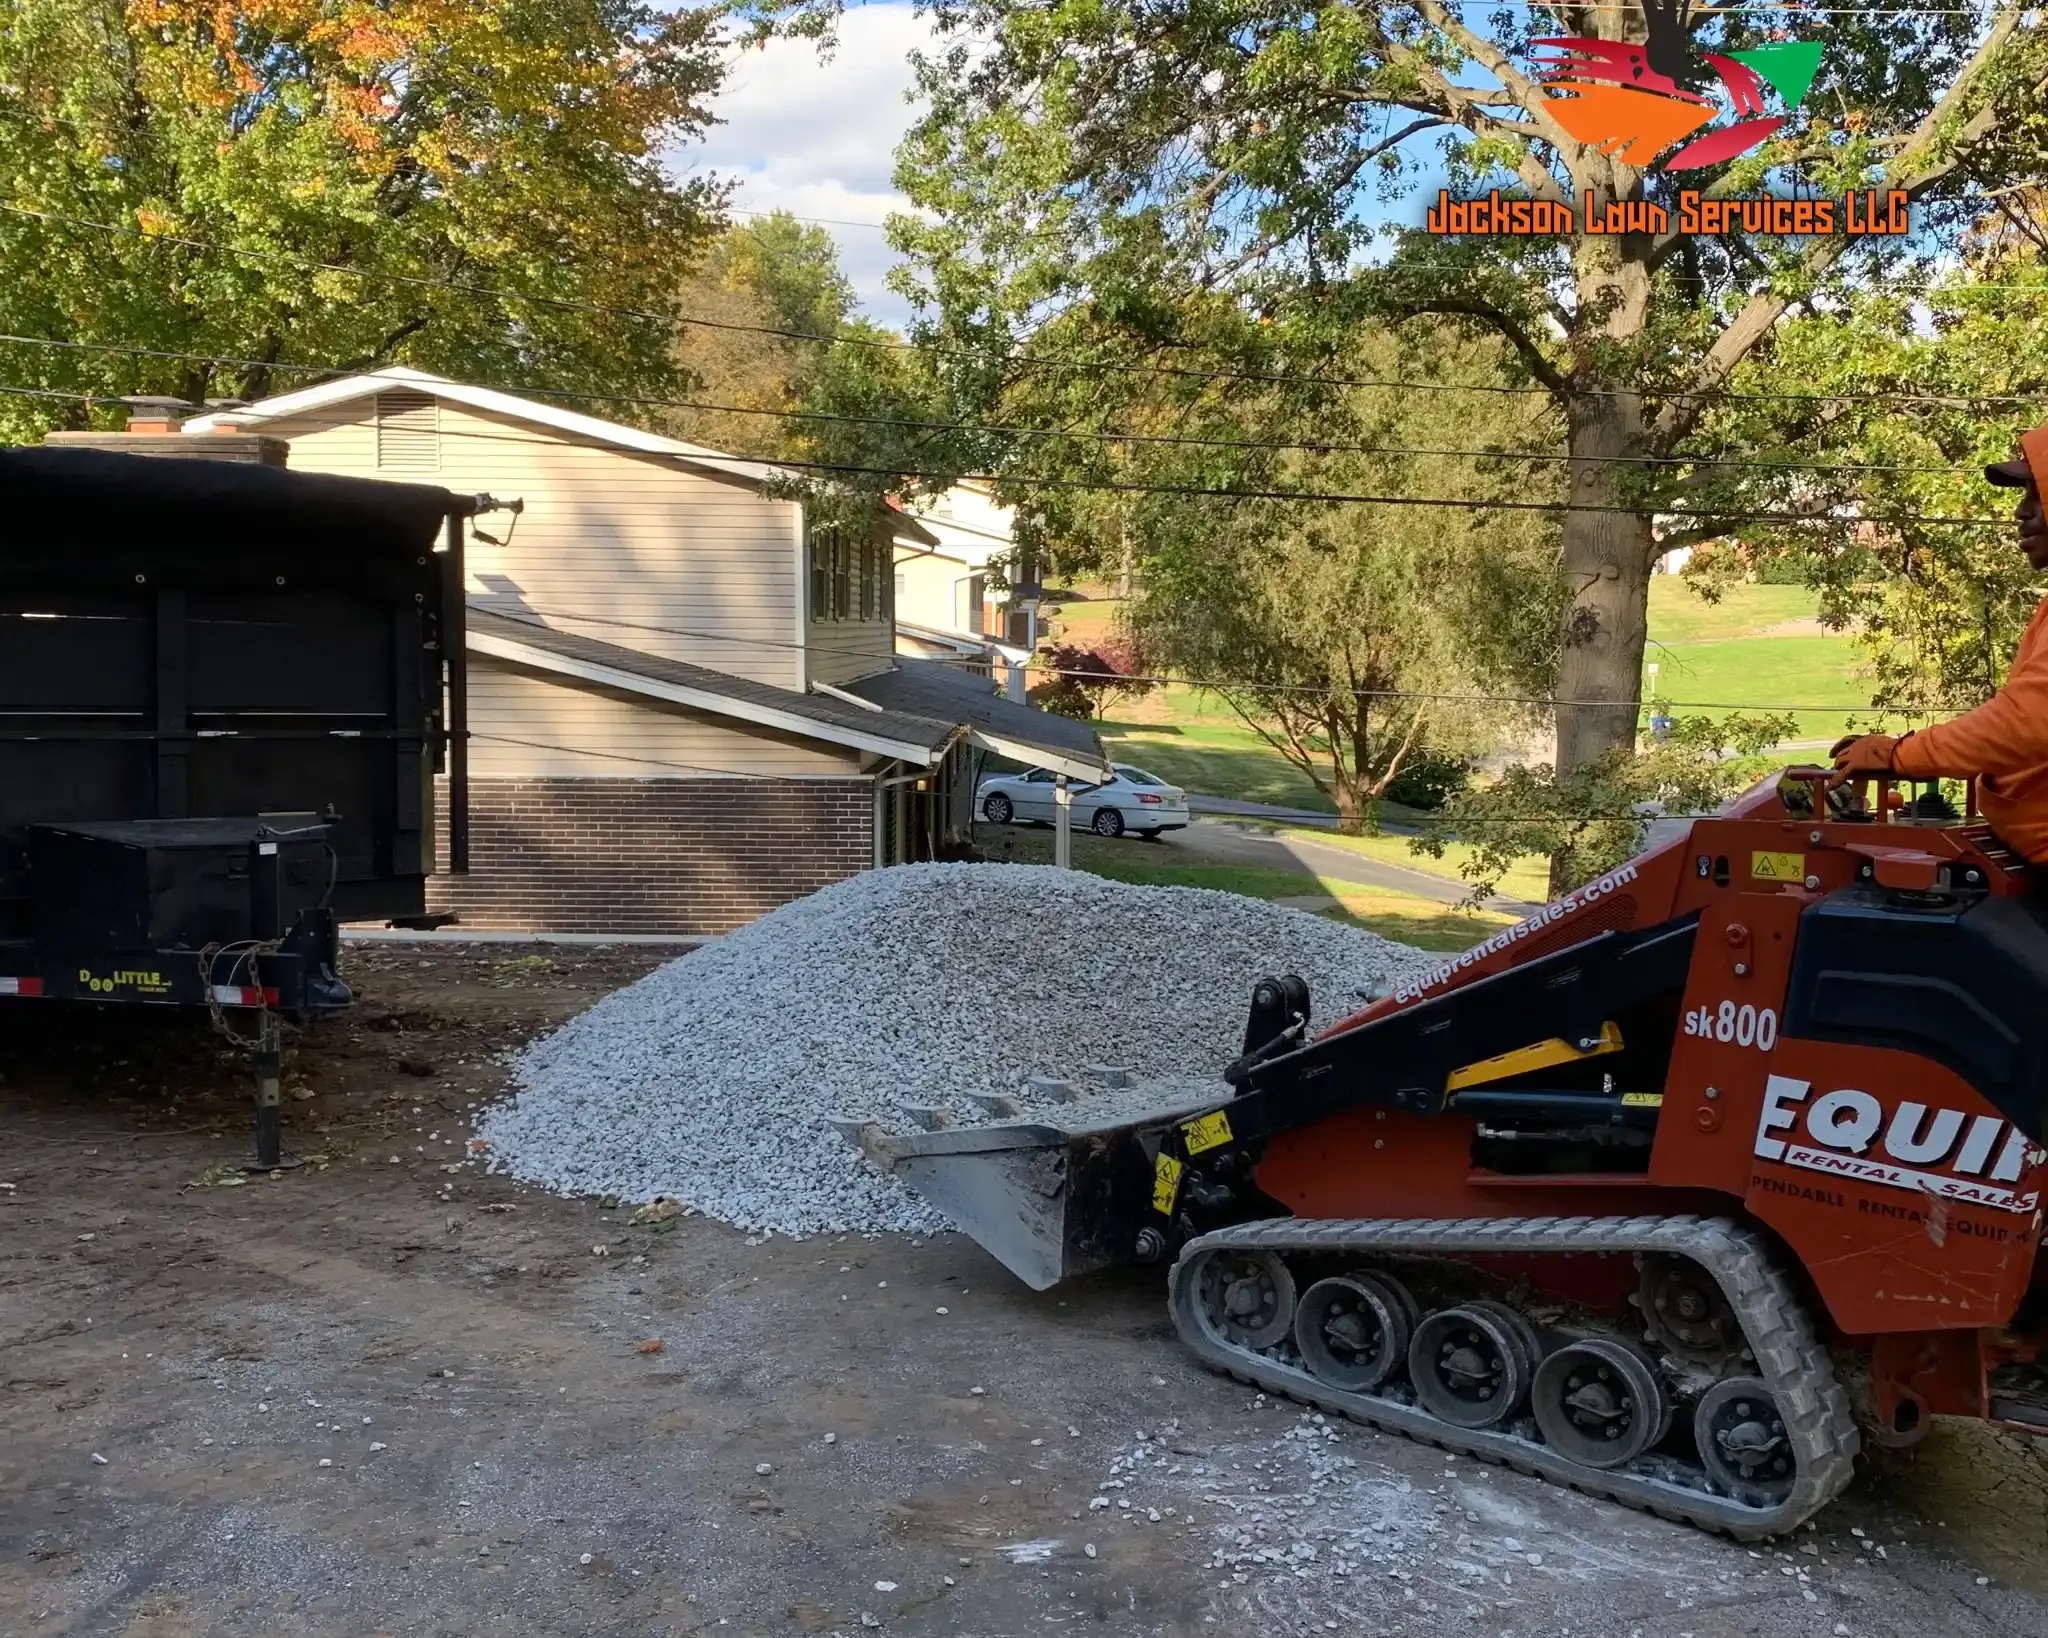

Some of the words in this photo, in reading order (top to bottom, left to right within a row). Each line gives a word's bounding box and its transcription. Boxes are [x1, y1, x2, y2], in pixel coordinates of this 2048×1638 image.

[1394, 865, 1638, 1004] equiprentalsales.com
[1684, 1000, 1777, 1051] sk800
[1791, 1151, 1901, 1182] RENTAL
